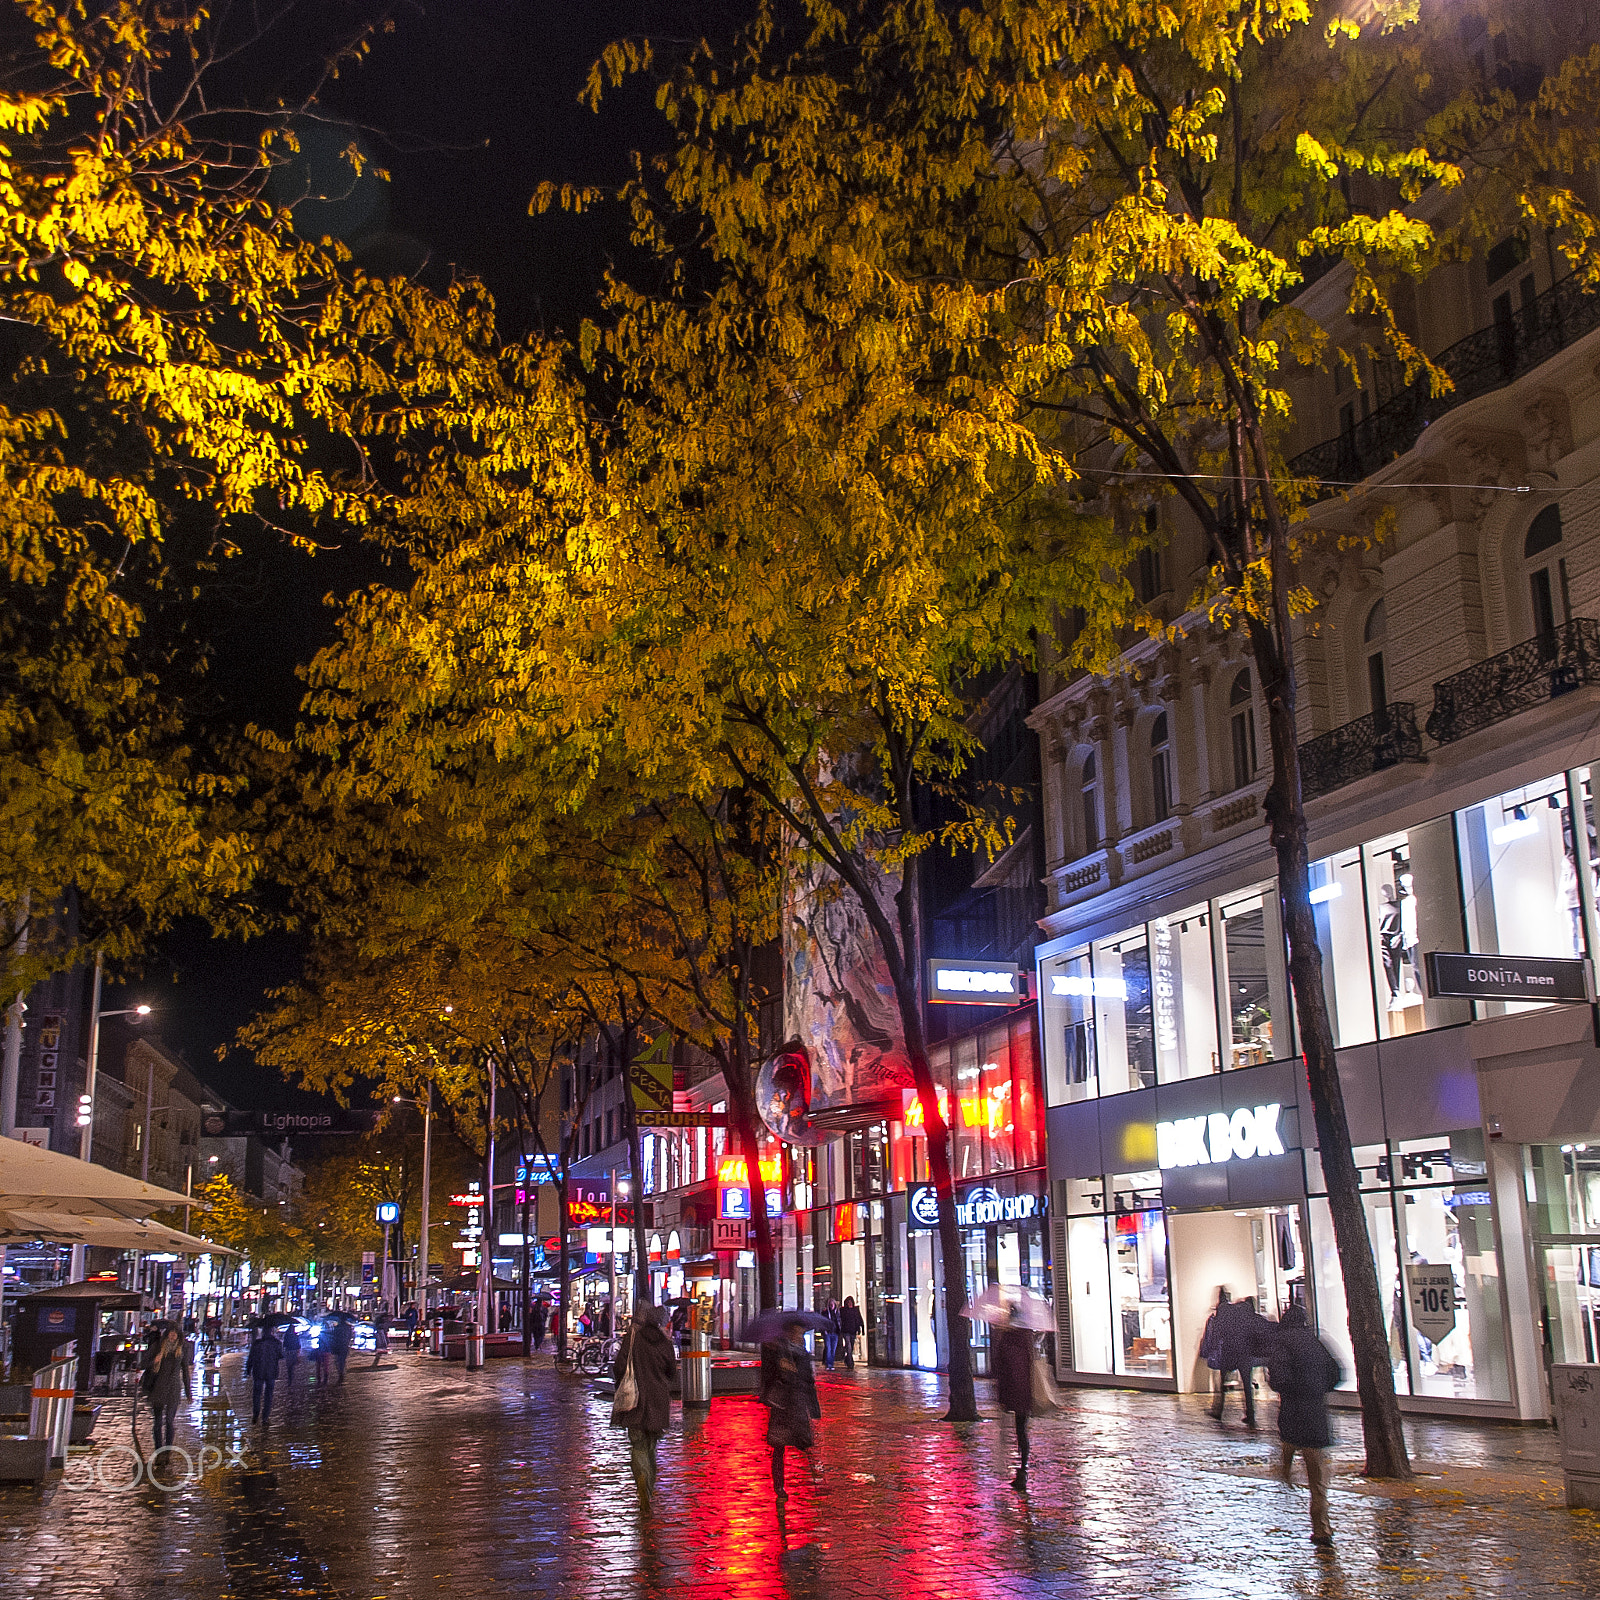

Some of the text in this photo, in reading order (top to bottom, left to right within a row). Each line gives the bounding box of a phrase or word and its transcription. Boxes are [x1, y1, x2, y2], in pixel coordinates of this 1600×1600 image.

[1526, 975, 1555, 985] men
[629, 1065, 671, 1106] GESTA
[263, 1113, 332, 1130] Lightopia
[1207, 1103, 1285, 1163] BOK
[380, 1207, 396, 1221] U
[956, 1194, 1035, 1225] THE BODY SHOP
[1414, 1288, 1450, 1312] -10€
